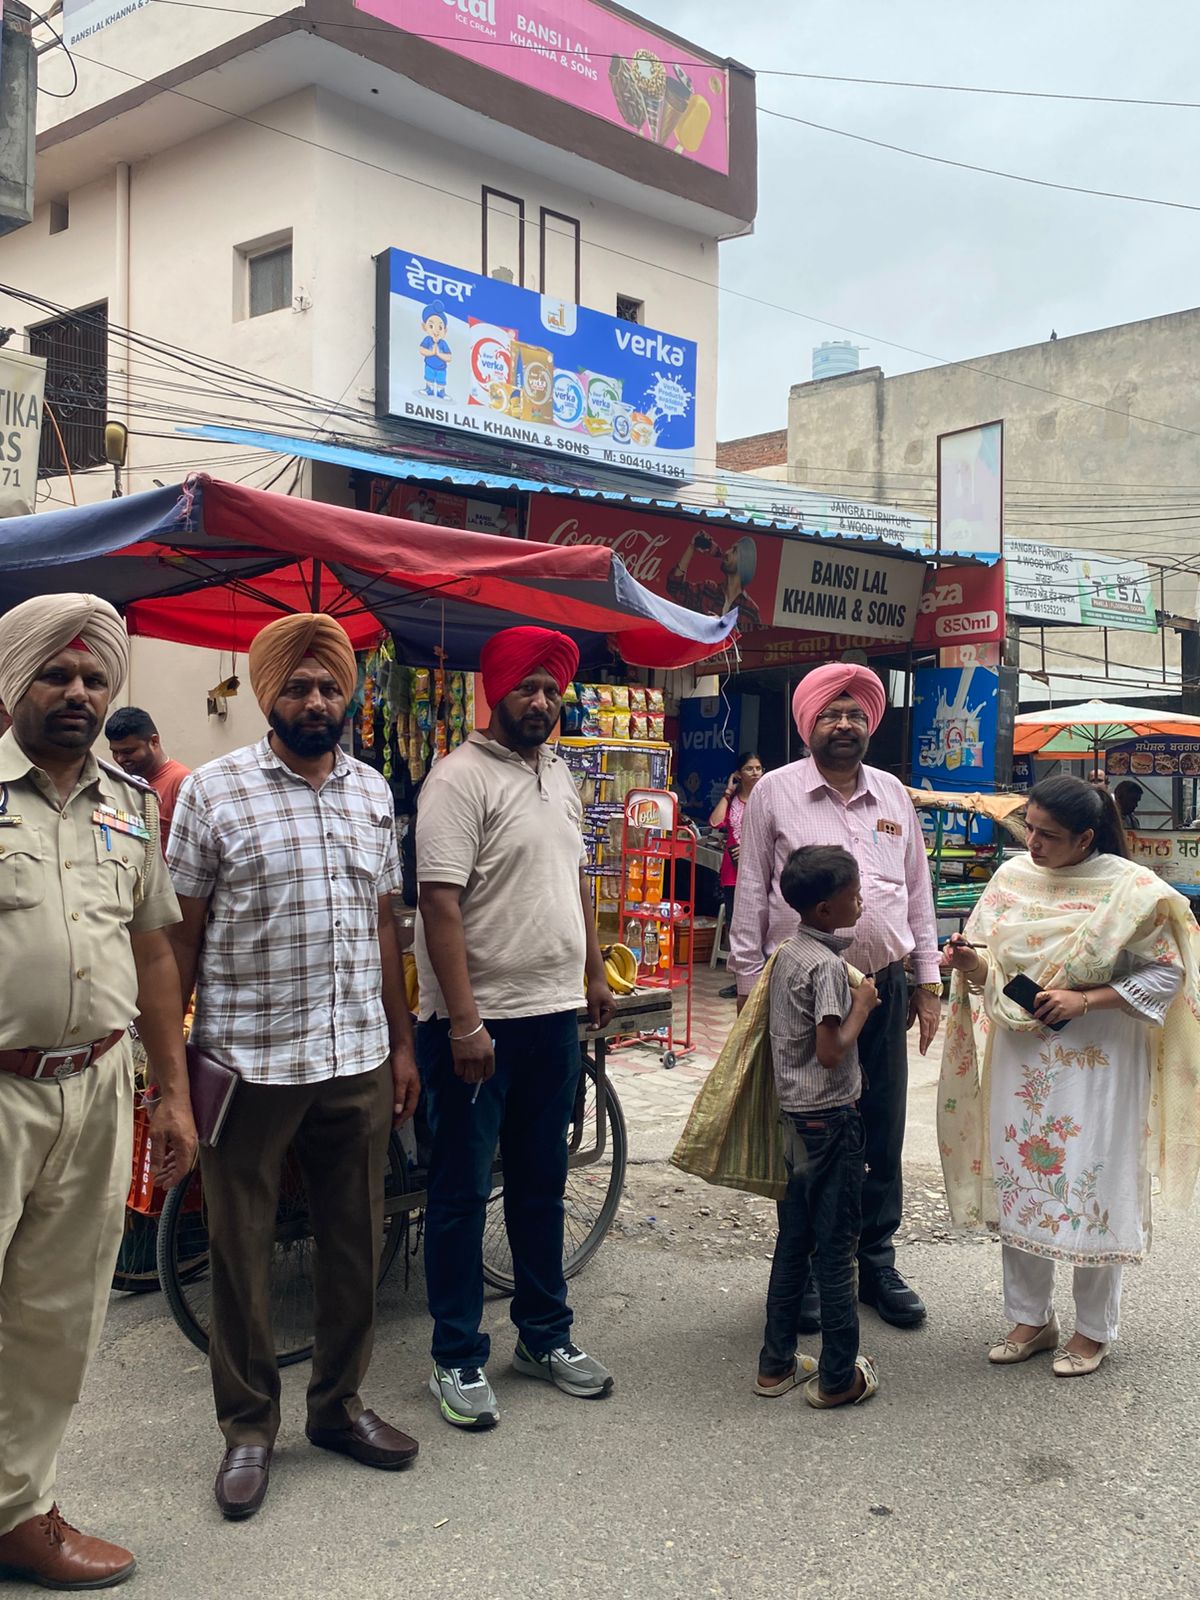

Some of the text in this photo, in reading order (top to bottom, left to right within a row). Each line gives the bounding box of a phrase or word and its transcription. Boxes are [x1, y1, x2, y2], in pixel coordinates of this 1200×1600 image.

[70, 27, 92, 45] BANSI
[92, 21, 104, 34] LAL
[105, 3, 137, 26] KHANNA
[442, 0, 496, 25] al
[455, 13, 497, 38] ICE CREAM
[517, 14, 592, 63] BANSI LAL
[510, 31, 598, 81] KHANNA & SONS
[405, 258, 473, 303] ਵੇਰਕਾ
[615, 329, 684, 367] verka
[482, 360, 504, 371] verka
[555, 391, 576, 403] verka
[405, 402, 686, 478] BANSI LAL KHANNA & SONS M: 90410-11361
[3, 467, 21, 487] 71
[830, 501, 912, 529] JANGRA FURNITURE
[840, 519, 905, 542] & WOOD WORKS
[1010, 541, 1073, 562] JANGRA FURNITURE
[811, 559, 888, 596] BANSI LAL
[1023, 556, 1044, 569] WOOD
[1046, 561, 1069, 574] WORKS
[1092, 581, 1142, 604] TESA
[783, 588, 906, 628] KHANNA & SONS
[943, 615, 991, 633] 850ml
[682, 724, 735, 750] verka
